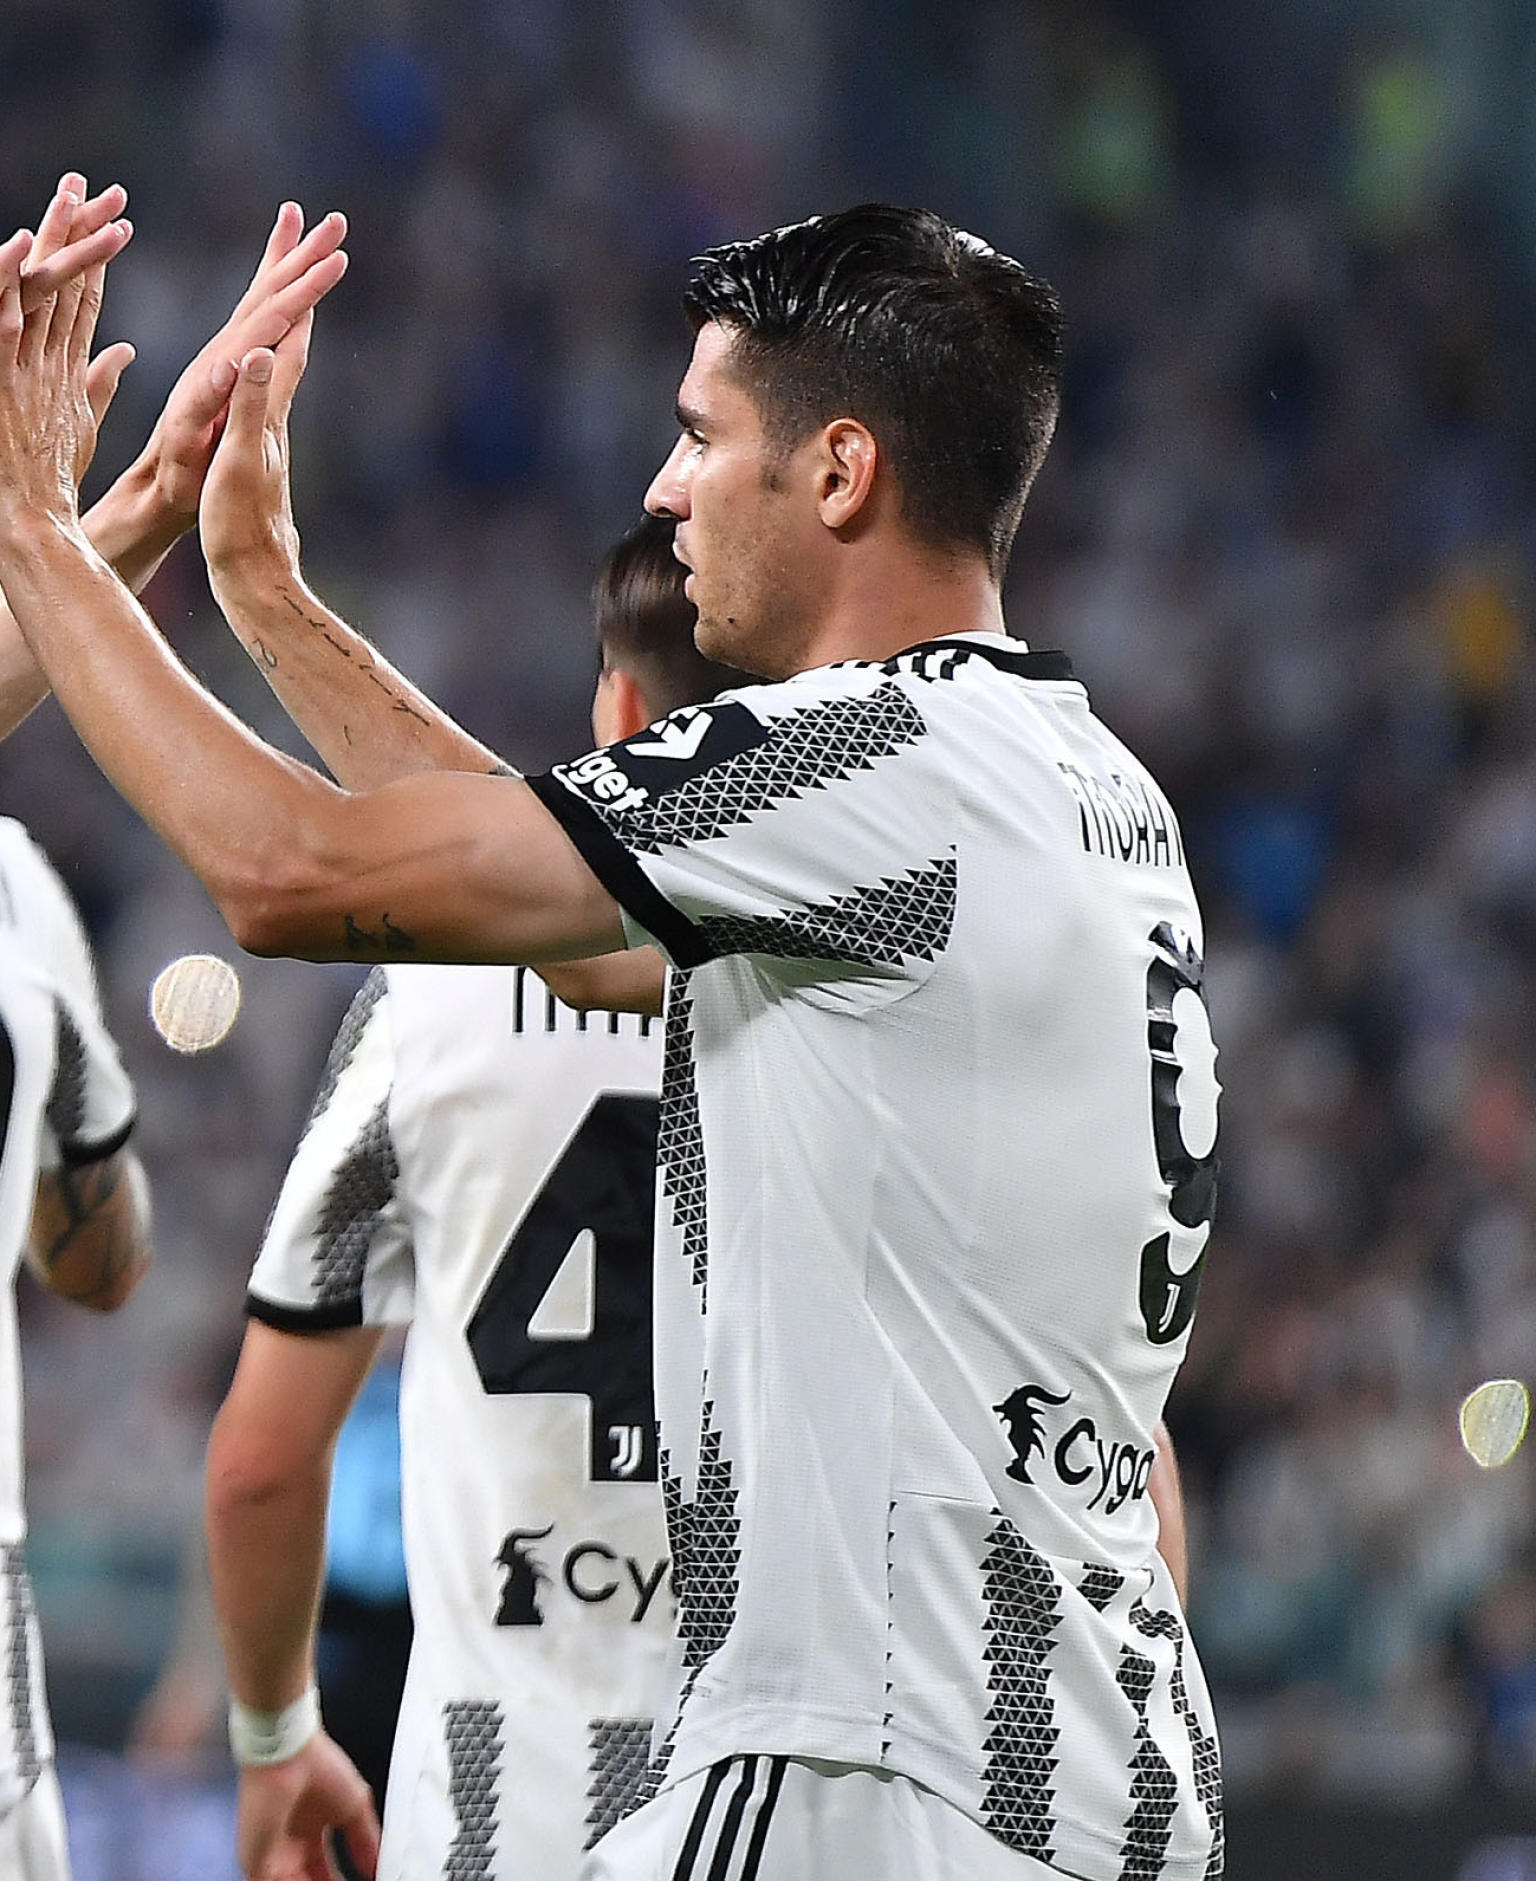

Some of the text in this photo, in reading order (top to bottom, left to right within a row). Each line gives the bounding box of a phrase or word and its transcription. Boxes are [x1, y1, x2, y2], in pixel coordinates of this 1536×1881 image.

[466, 1090, 660, 1484] 4
[1138, 919, 1224, 1346] 9
[562, 1539, 678, 1622] Cy
